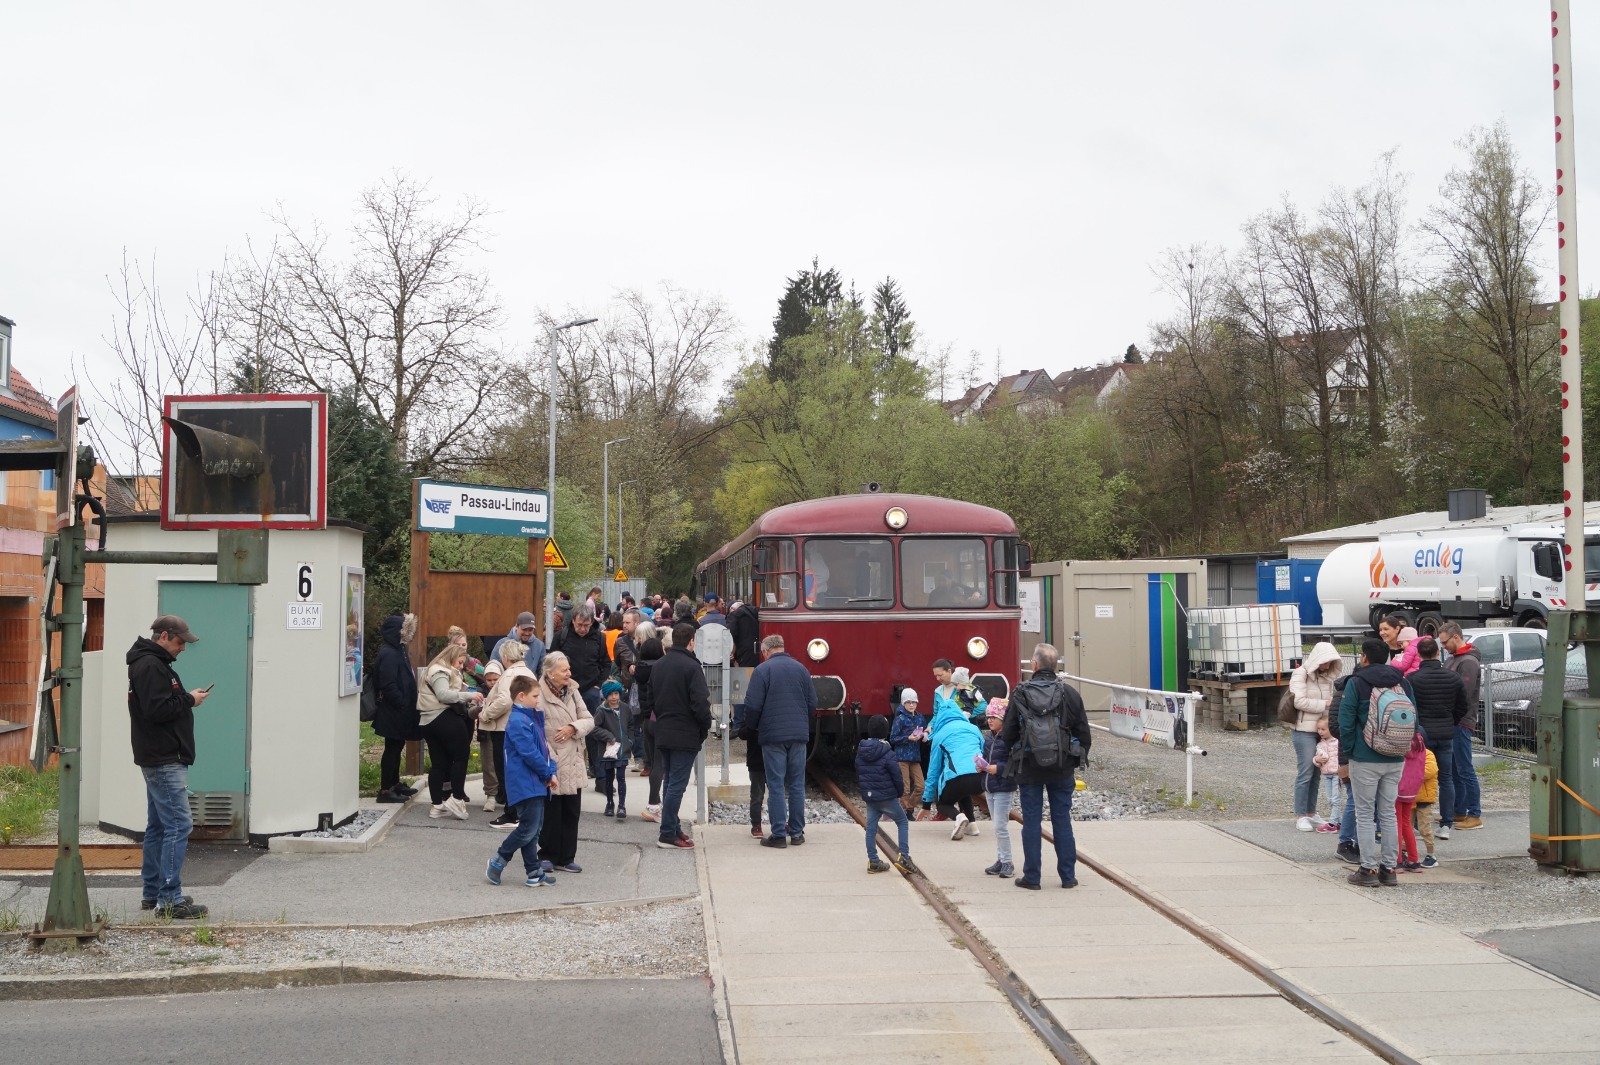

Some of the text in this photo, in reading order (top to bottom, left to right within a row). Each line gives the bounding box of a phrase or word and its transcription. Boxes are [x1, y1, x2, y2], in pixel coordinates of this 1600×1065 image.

[432, 502, 452, 514] BRE
[461, 493, 541, 513] Passau-Lindau
[298, 565, 312, 598] 6
[305, 606, 319, 615] KM
